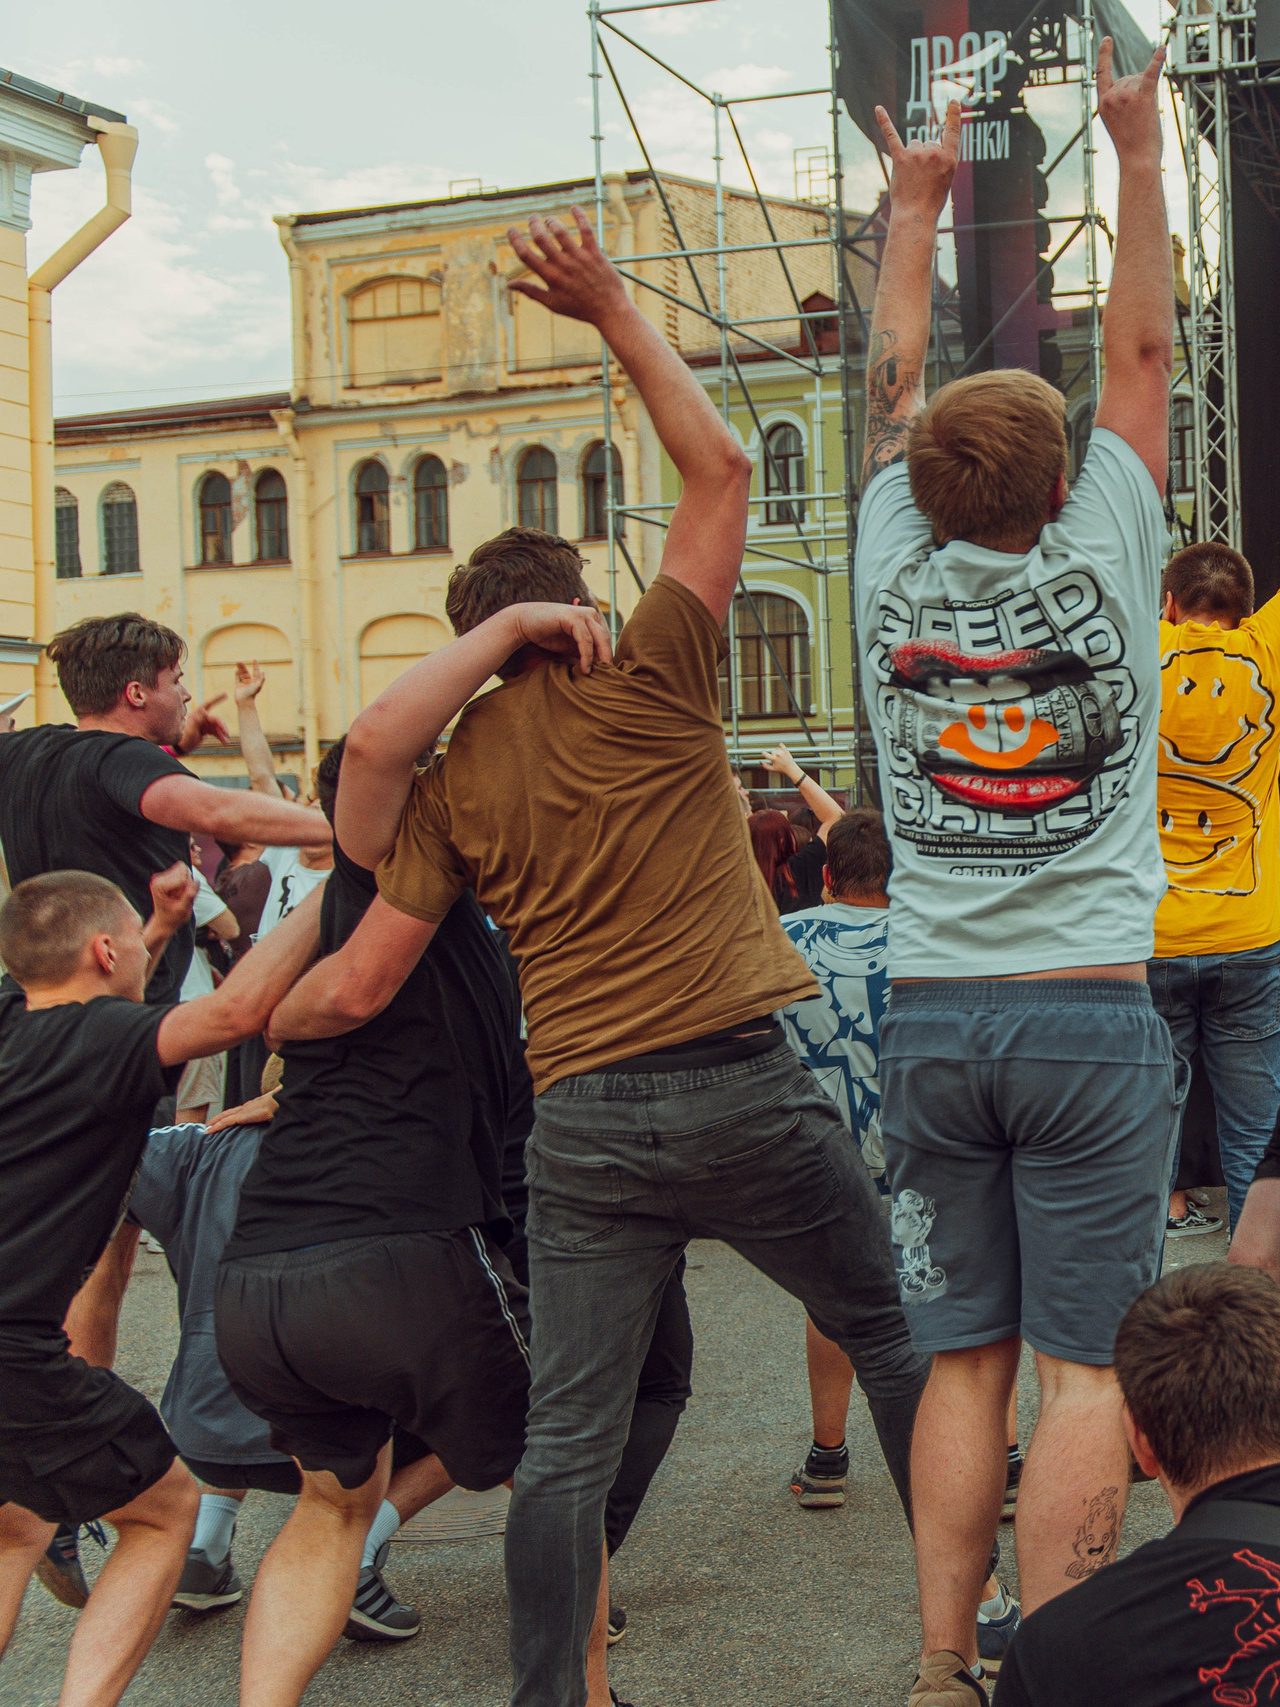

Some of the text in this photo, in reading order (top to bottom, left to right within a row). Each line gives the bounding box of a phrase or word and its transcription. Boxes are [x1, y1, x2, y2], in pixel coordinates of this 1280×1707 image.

[906, 120, 1010, 162] ГОИНКИ
[937, 846, 955, 854] WAS
[962, 846, 992, 855] DEFEAT
[993, 846, 1025, 855] BETTER
[1025, 846, 1049, 854] THAN
